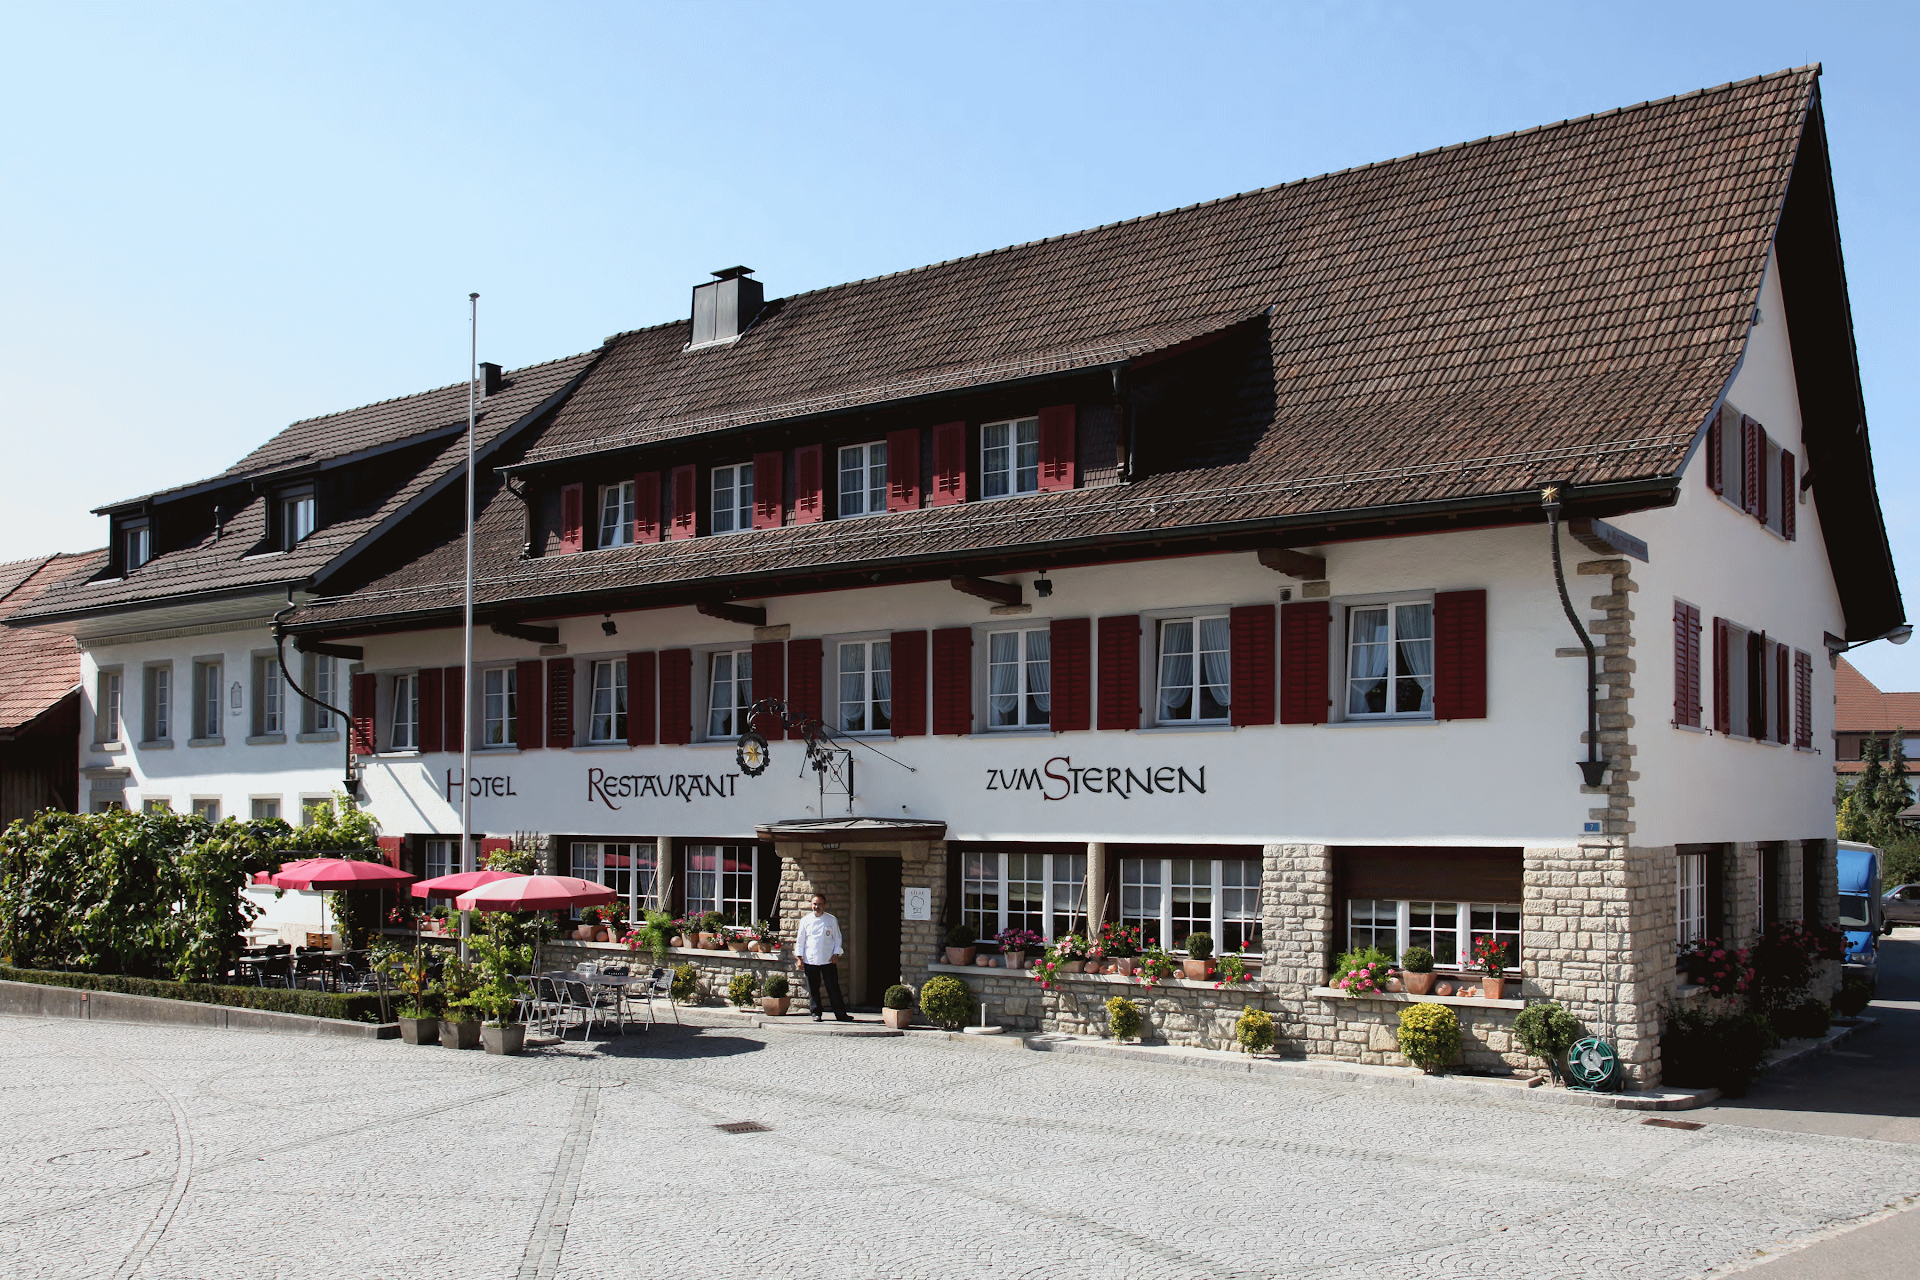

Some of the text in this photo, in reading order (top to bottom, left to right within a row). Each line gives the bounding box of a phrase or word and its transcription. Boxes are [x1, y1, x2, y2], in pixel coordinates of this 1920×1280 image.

[446, 755, 1207, 811] HOTEL RESTAURANT ZUM STERNEN
